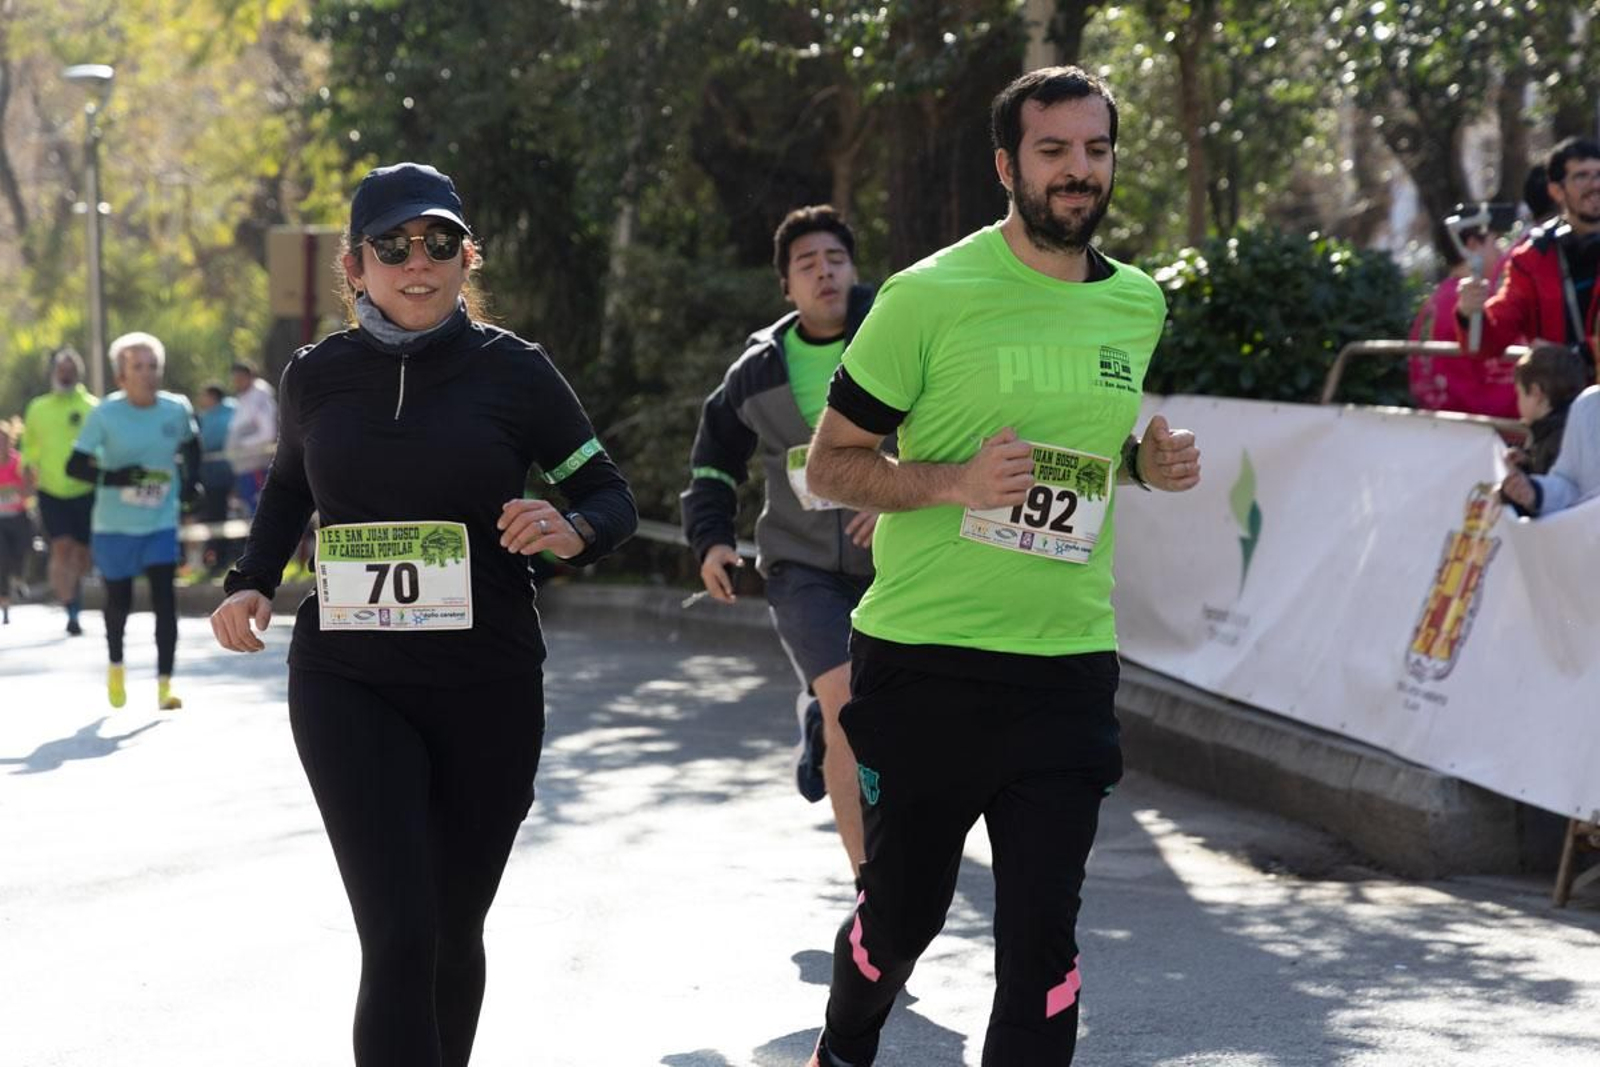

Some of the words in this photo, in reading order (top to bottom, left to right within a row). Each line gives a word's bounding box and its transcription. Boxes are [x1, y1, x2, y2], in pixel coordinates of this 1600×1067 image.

[1055, 452, 1079, 469] BOSCO
[1037, 464, 1071, 481] POPULAR
[345, 529, 364, 542] SAN
[366, 528, 389, 542] JUAN
[392, 527, 420, 541] BOSCO
[328, 544, 338, 557] IV
[340, 543, 376, 559] CARRERA
[378, 542, 414, 558] POPULAR
[365, 561, 420, 605] 70
